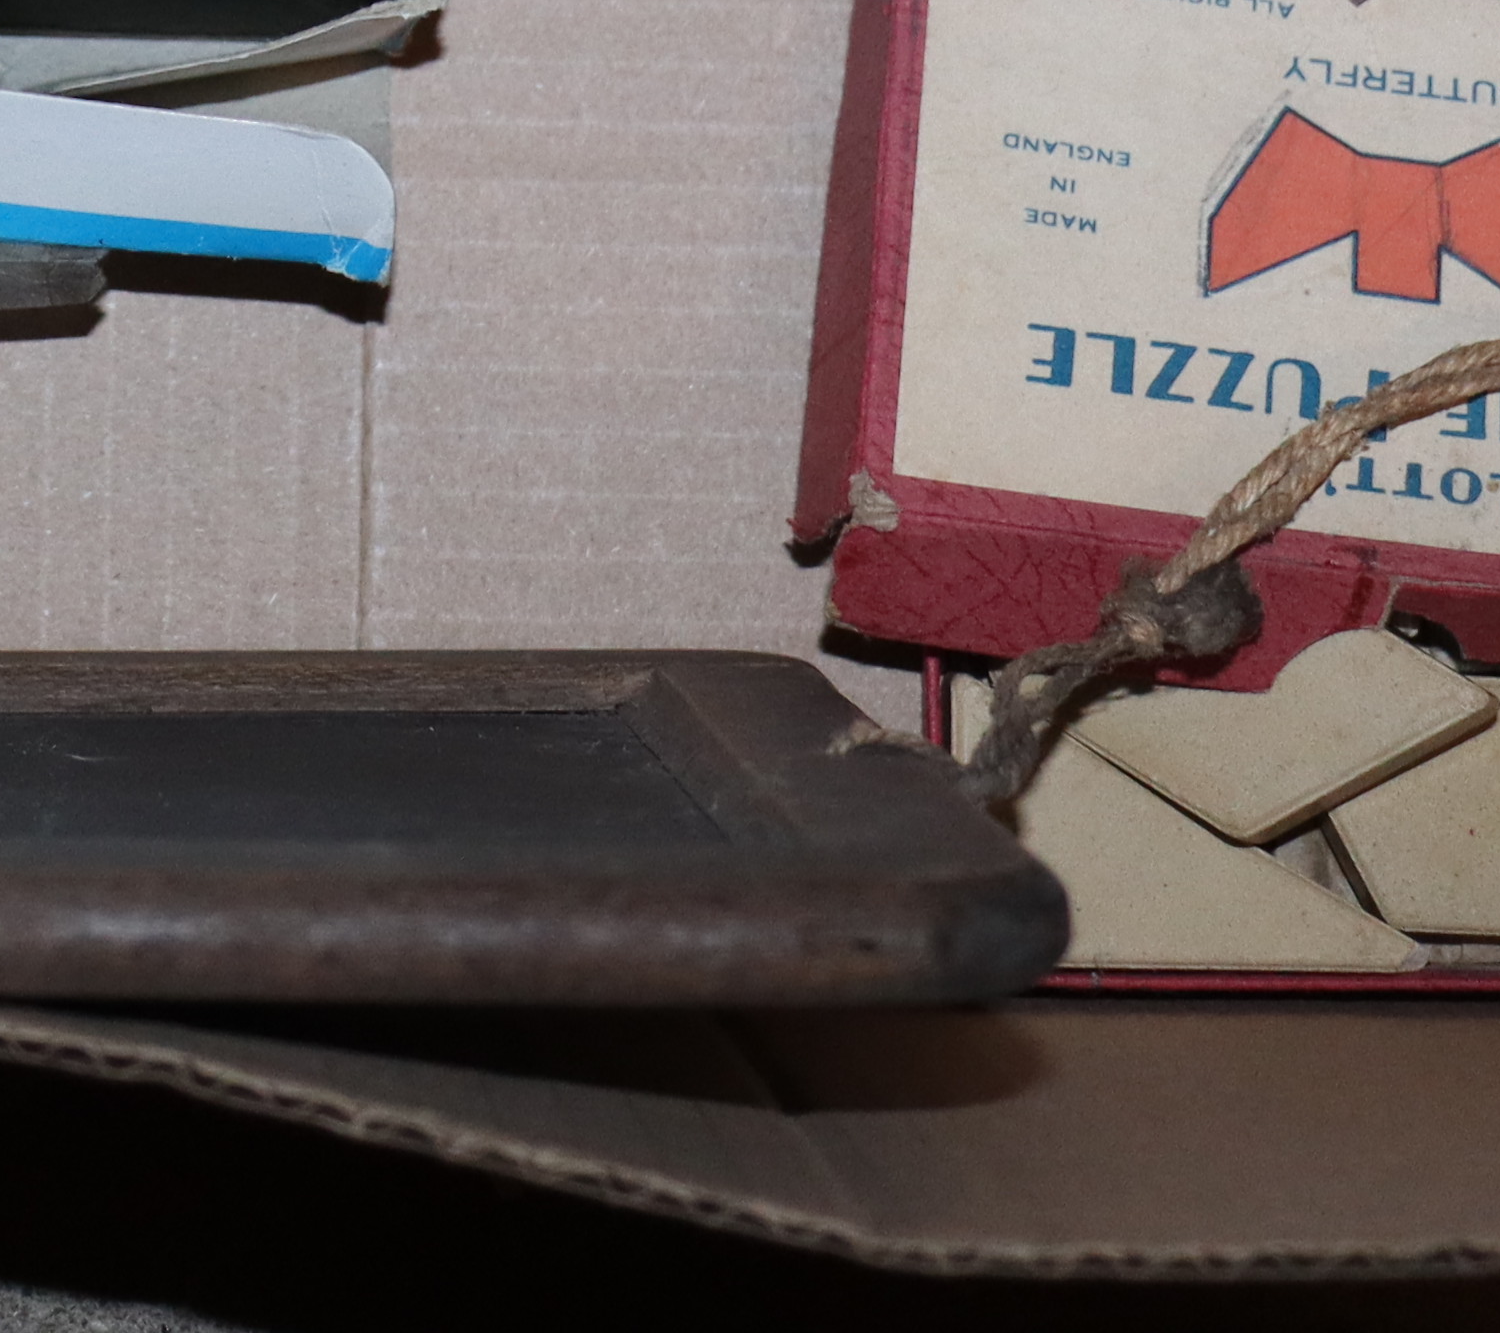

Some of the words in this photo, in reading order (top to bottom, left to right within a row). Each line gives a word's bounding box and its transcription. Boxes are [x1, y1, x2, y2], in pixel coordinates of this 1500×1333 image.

[1003, 132, 1131, 167] ENGLAND
[1050, 176, 1075, 193] IN
[1024, 207, 1097, 233] MADE
